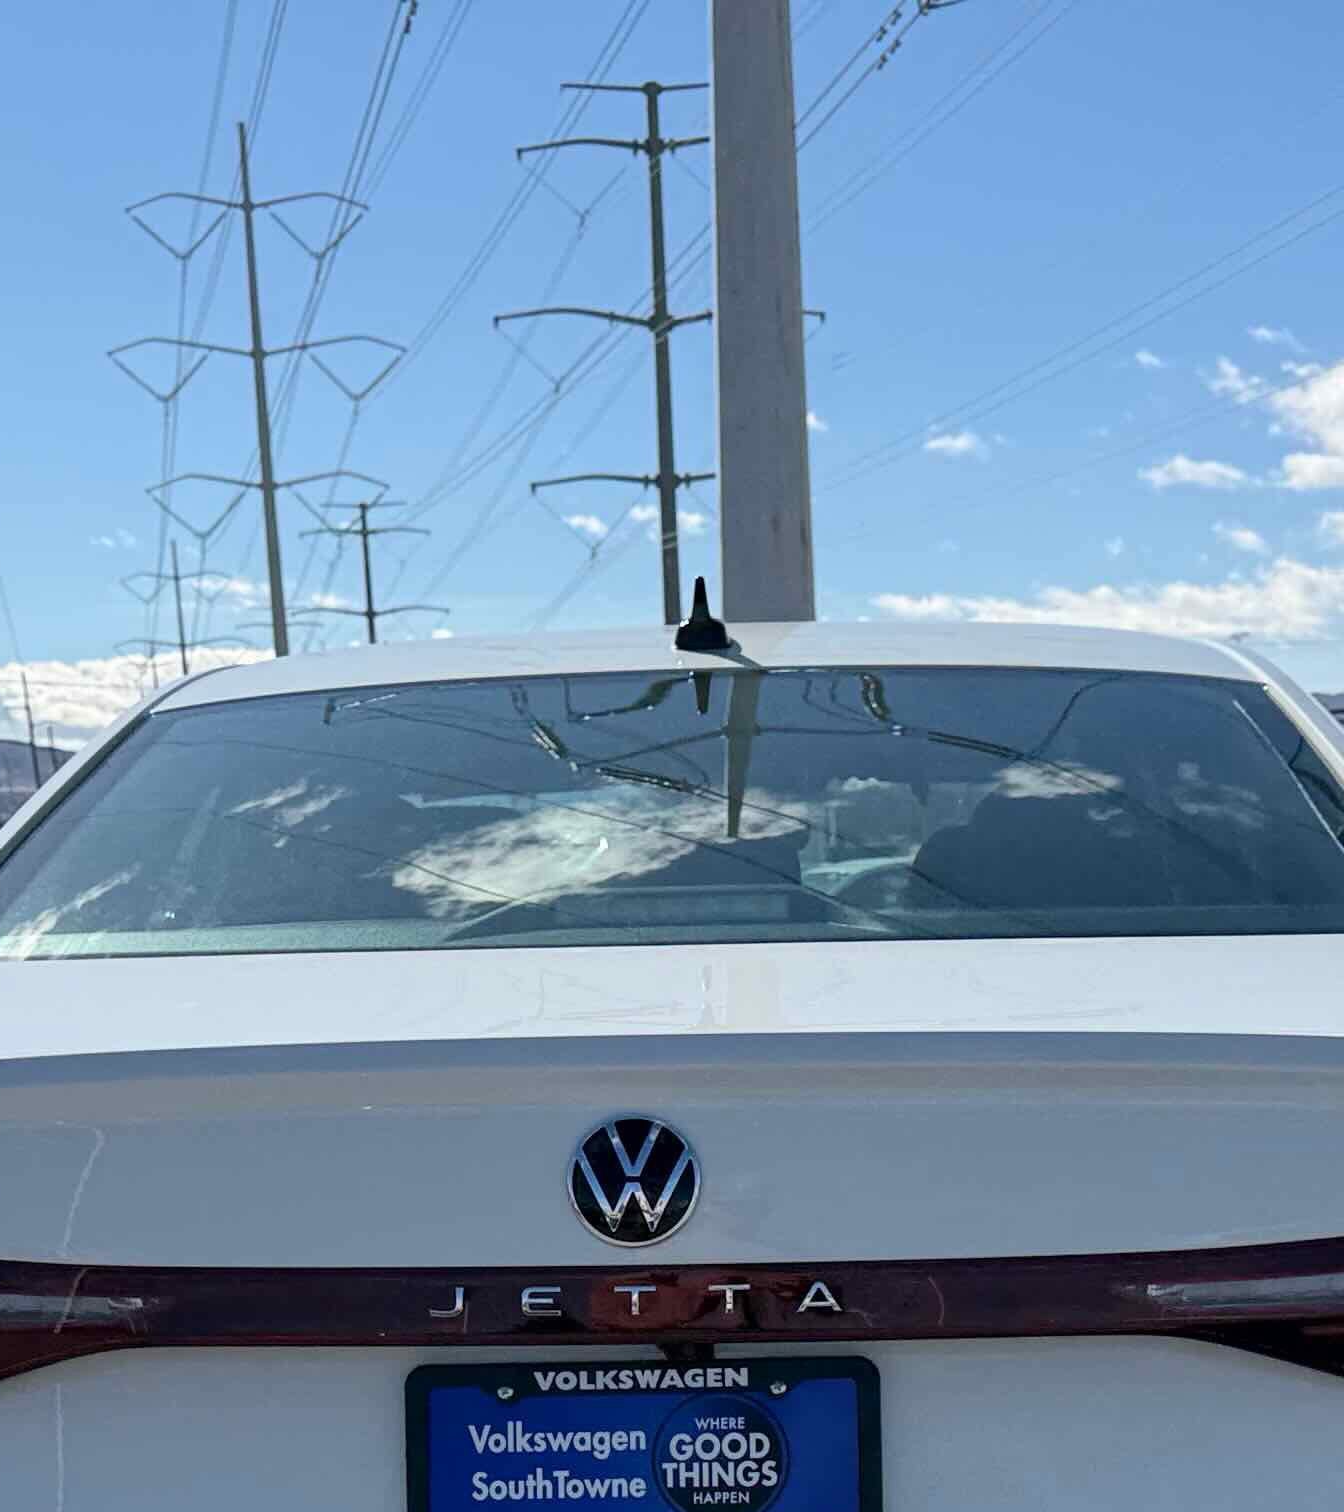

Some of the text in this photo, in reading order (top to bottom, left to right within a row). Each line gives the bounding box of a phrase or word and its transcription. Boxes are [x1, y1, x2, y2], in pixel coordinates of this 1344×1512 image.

[567, 1118, 699, 1244] VW
[430, 1281, 843, 1318] JETTA
[533, 1367, 749, 1392] VOLKSWAGEN
[695, 1417, 746, 1430] WHERE
[468, 1421, 647, 1460] Volkswagen
[669, 1432, 771, 1461] GOOD
[472, 1468, 647, 1501] SouthTowne
[662, 1460, 779, 1488] THINGS
[693, 1491, 750, 1505] HAPPEN
